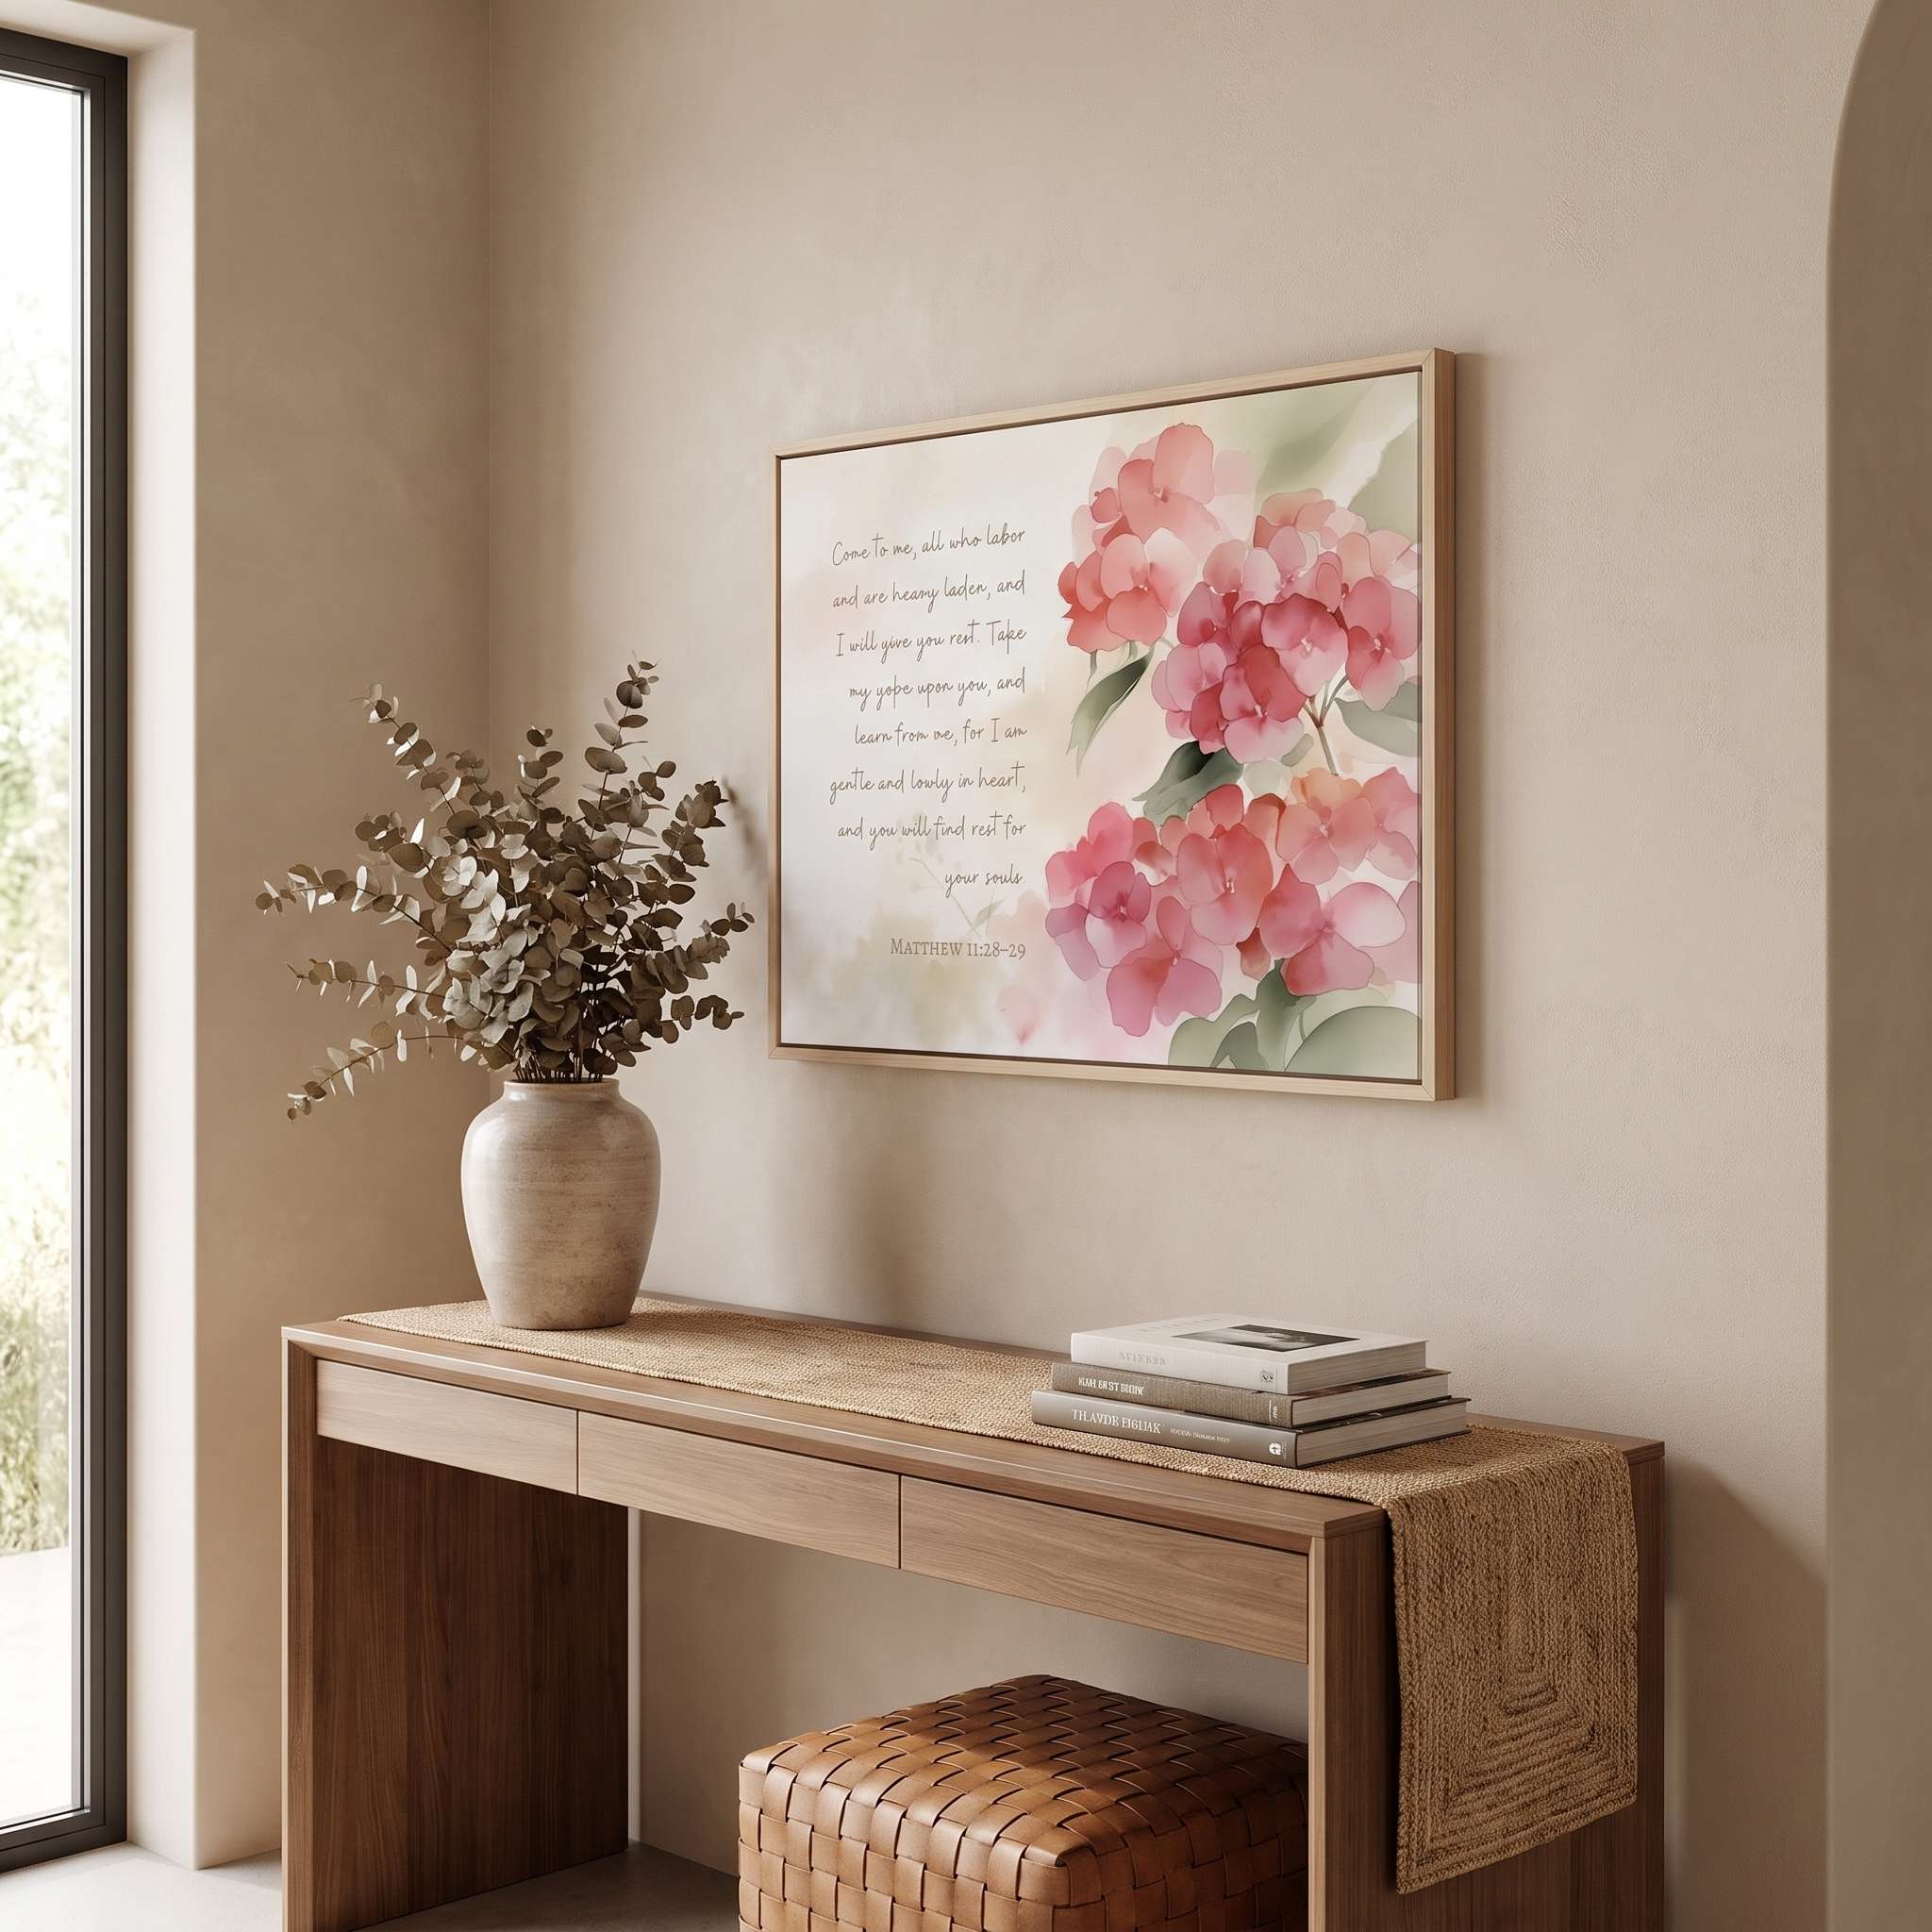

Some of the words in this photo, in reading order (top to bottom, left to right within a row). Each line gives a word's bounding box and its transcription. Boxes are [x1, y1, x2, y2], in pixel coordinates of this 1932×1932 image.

[832, 541, 871, 566] Come
[872, 533, 888, 558] to
[893, 542, 917, 560] me,
[923, 530, 944, 553] all
[950, 527, 981, 548] who
[987, 523, 1025, 545] labor
[833, 585, 858, 608] and
[864, 593, 888, 605] are
[944, 574, 991, 600] laden,
[997, 570, 1025, 595] and
[836, 633, 844, 657] I
[850, 631, 877, 652] will
[882, 636, 912, 664] give
[916, 636, 944, 662] you
[849, 688, 872, 711] my
[918, 681, 953, 708] upon
[958, 682, 991, 707] you,
[997, 667, 1025, 693] and
[855, 724, 891, 744] learn
[895, 722, 928, 746] from
[963, 719, 985, 743] for
[991, 718, 1000, 742] I
[1005, 727, 1027, 740] am
[830, 767, 874, 805] gentle
[877, 770, 905, 793] and
[911, 768, 954, 803] lowly
[958, 774, 974, 788] in
[979, 761, 1026, 792] heart,
[838, 817, 863, 840] and
[869, 826, 897, 851] you
[902, 815, 931, 837] will
[933, 815, 965, 841] find
[972, 810, 1003, 837] rest
[1004, 814, 1026, 841] for
[945, 874, 979, 898] your
